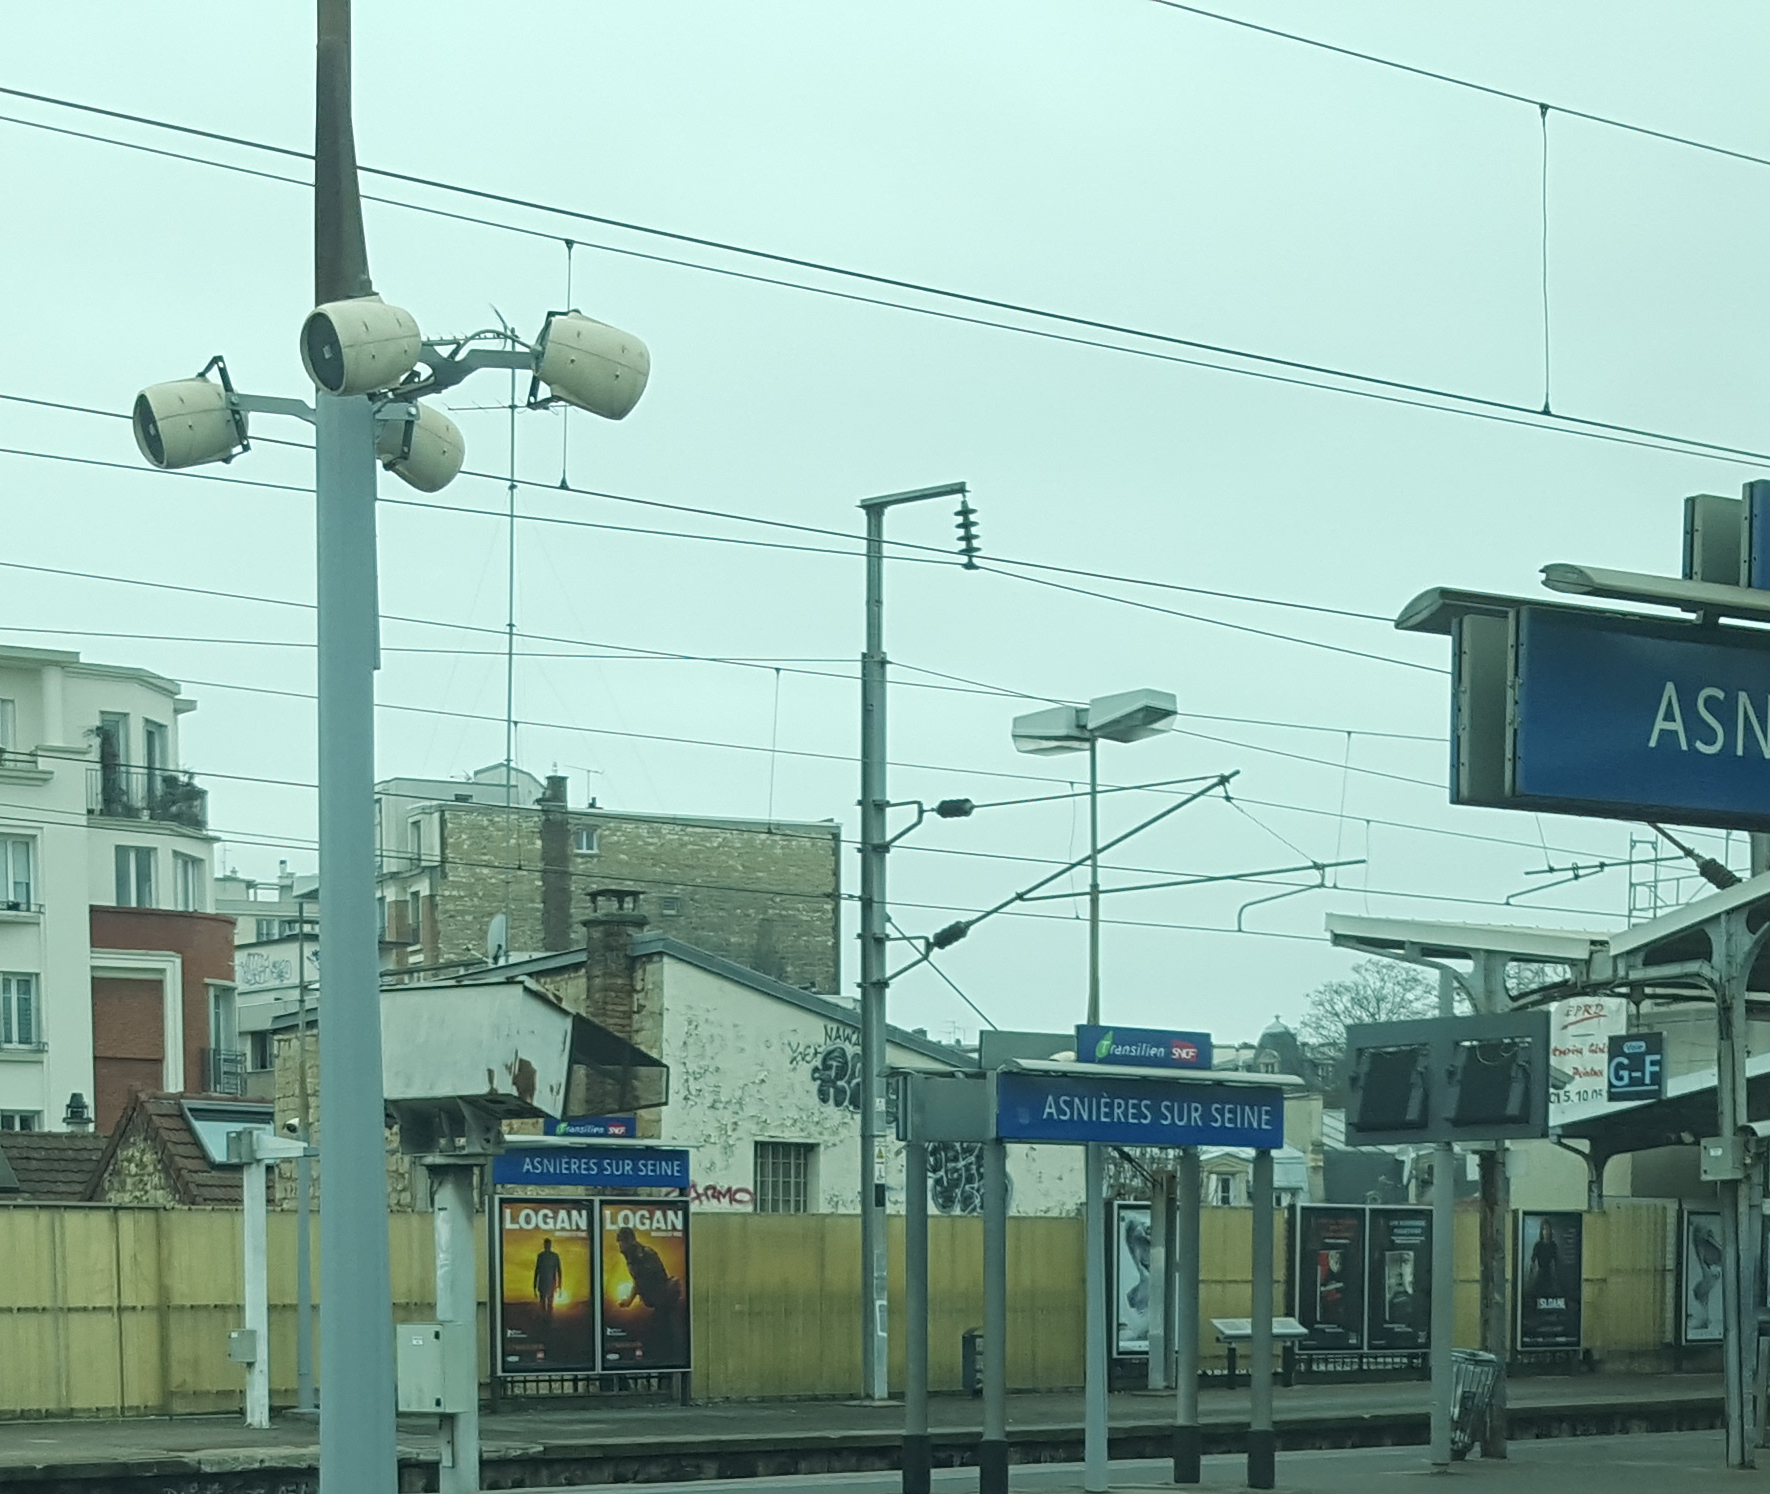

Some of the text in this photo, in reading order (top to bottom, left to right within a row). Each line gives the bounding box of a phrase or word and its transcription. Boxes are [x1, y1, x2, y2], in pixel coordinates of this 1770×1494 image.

[1097, 1038, 1198, 1060] Transilien SNCF
[1609, 1054, 1661, 1087] G-F
[1042, 1092, 1273, 1131] ASNIÈRES SUR SEINE
[608, 1126, 626, 1135] SNCF
[523, 1156, 682, 1177] ASNIÈRES SUR SEINE
[505, 1208, 588, 1230] LOGAN
[604, 1209, 683, 1231] LOGAN
